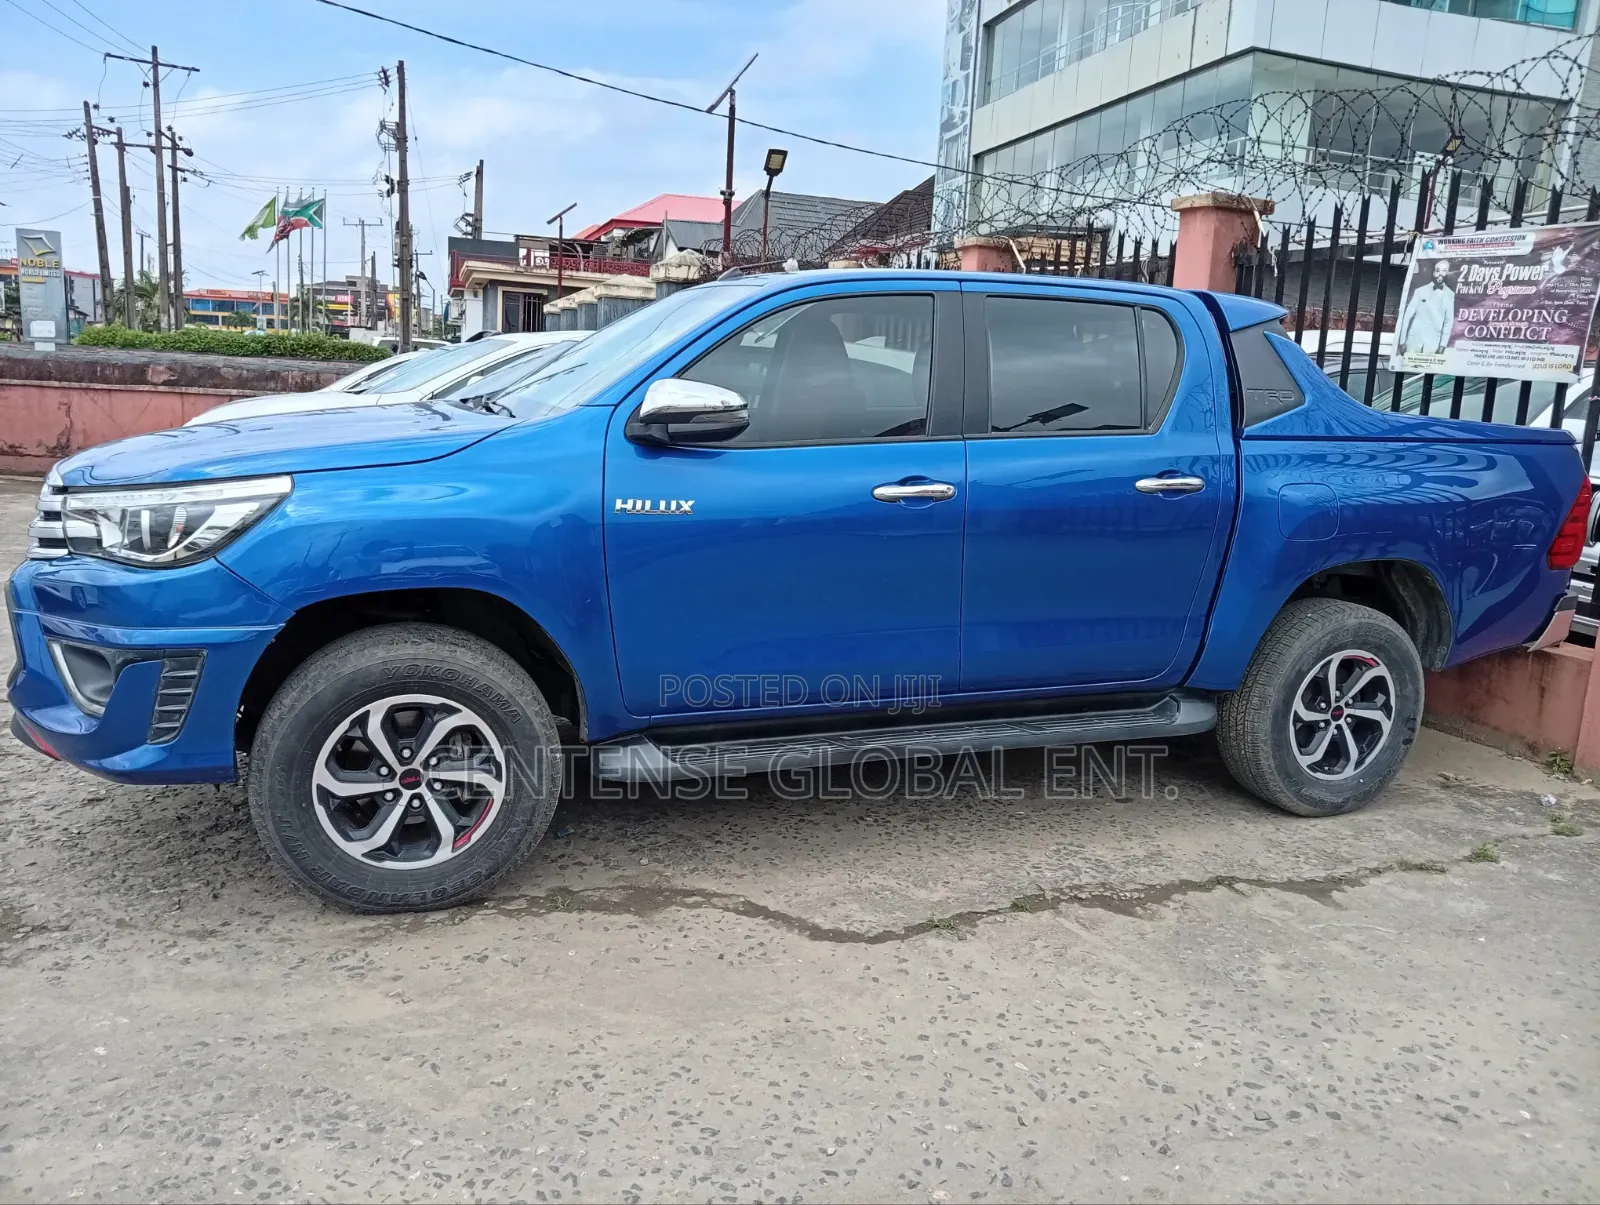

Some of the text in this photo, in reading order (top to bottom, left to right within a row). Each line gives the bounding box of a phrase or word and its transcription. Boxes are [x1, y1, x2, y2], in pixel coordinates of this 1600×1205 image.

[1485, 235, 1527, 243] CONFESSION
[20, 257, 60, 269] NOBLE
[21, 268, 61, 277] WORLD LIMITED
[1457, 263, 1549, 285] 2 Days Power
[1455, 279, 1537, 299] Packed Programme
[1457, 308, 1569, 324] DEVELOPING
[1464, 324, 1552, 341] CONFLICT
[1246, 387, 1295, 405] TRD
[613, 498, 696, 515] HILUX
[381, 663, 523, 725] YOKOHAMA
[309, 862, 485, 907] GEOLANDAR
